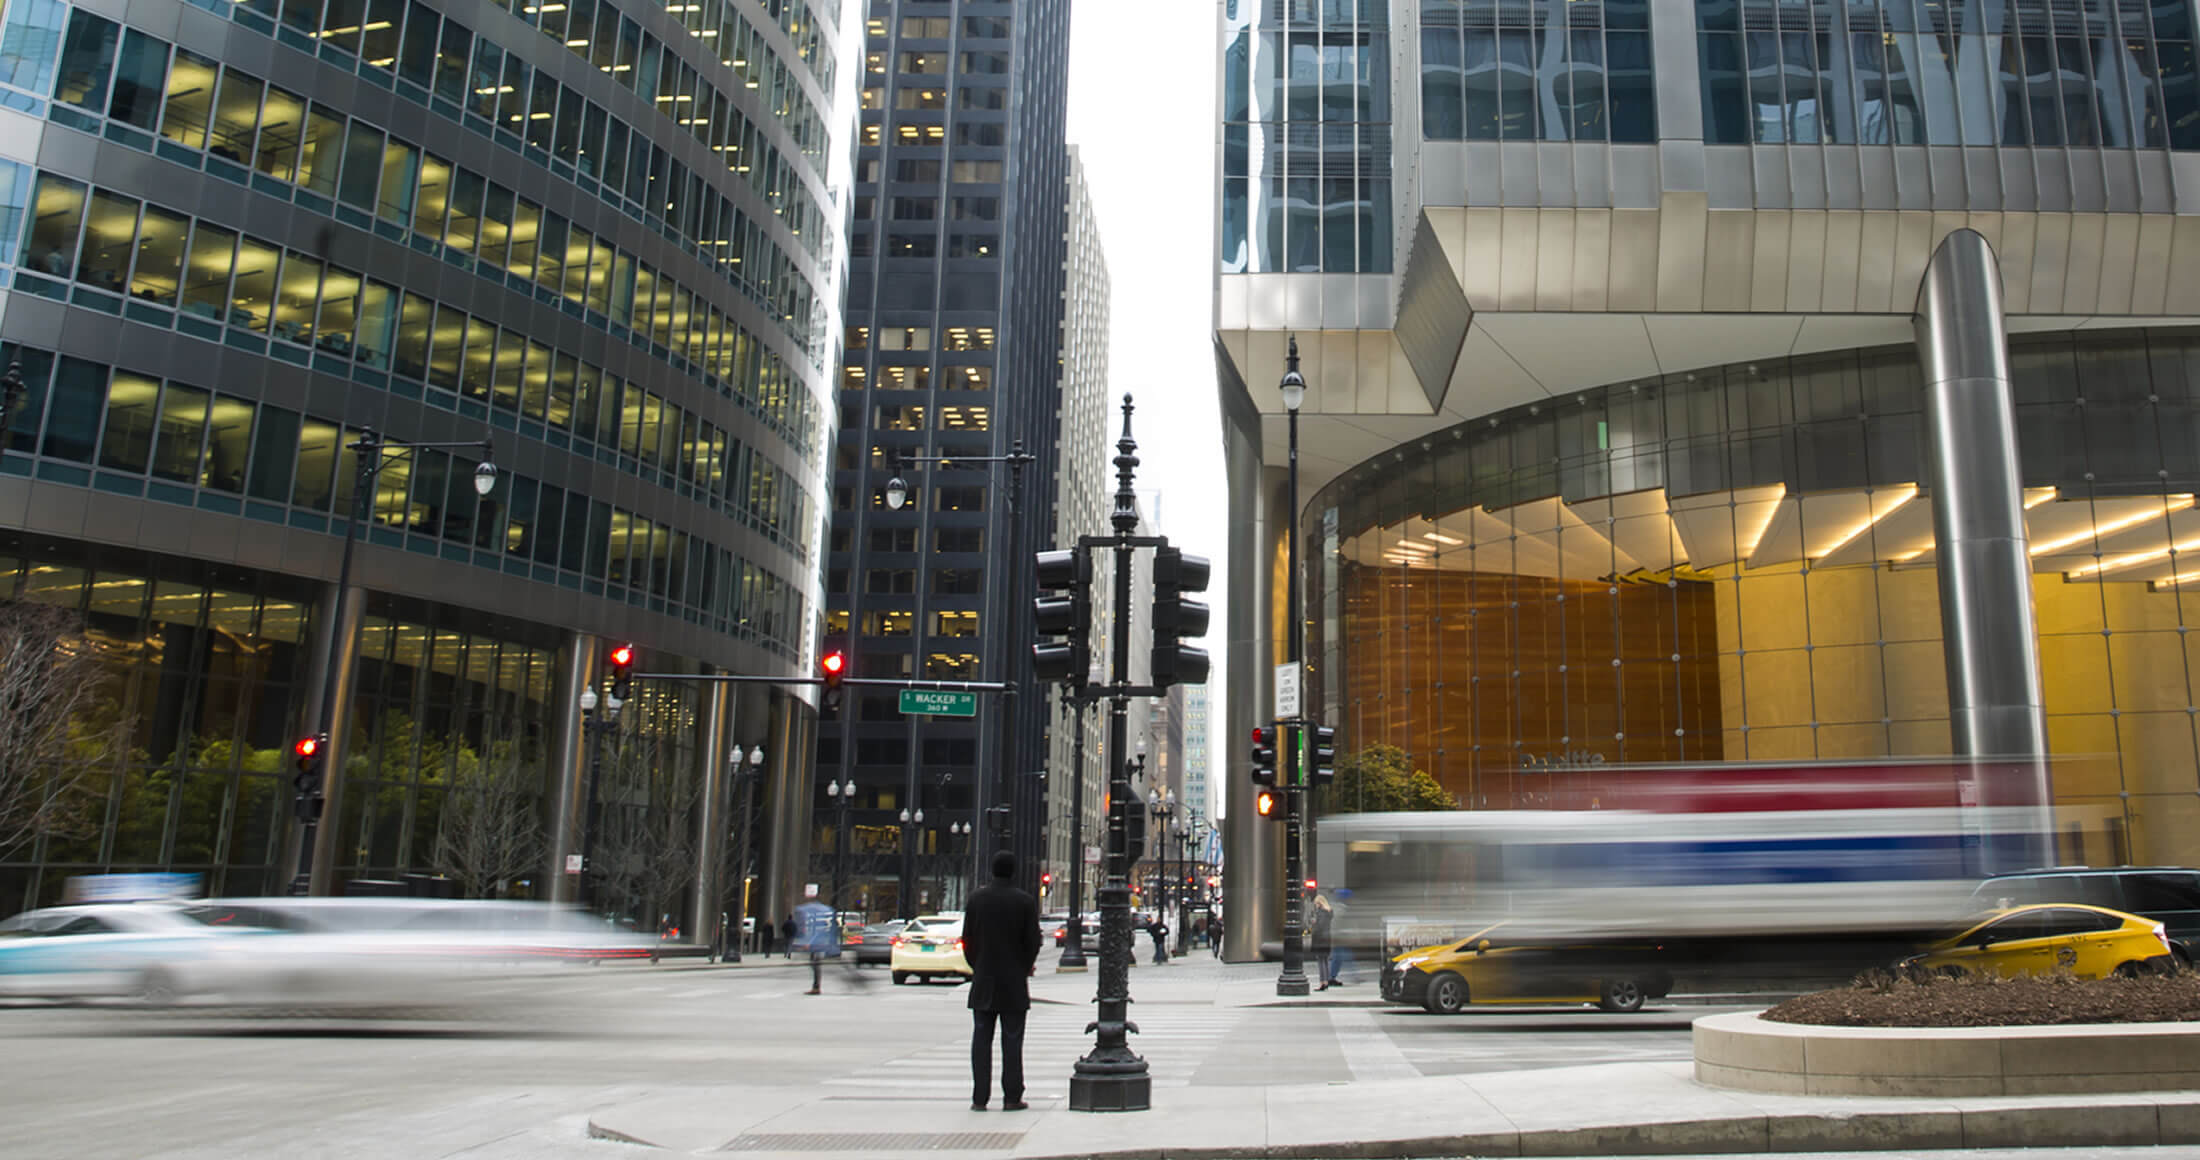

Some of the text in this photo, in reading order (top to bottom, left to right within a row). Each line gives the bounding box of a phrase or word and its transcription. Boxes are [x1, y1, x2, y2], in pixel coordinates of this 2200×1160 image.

[904, 692, 972, 704] S WACKER DR
[927, 704, 941, 712] 360
